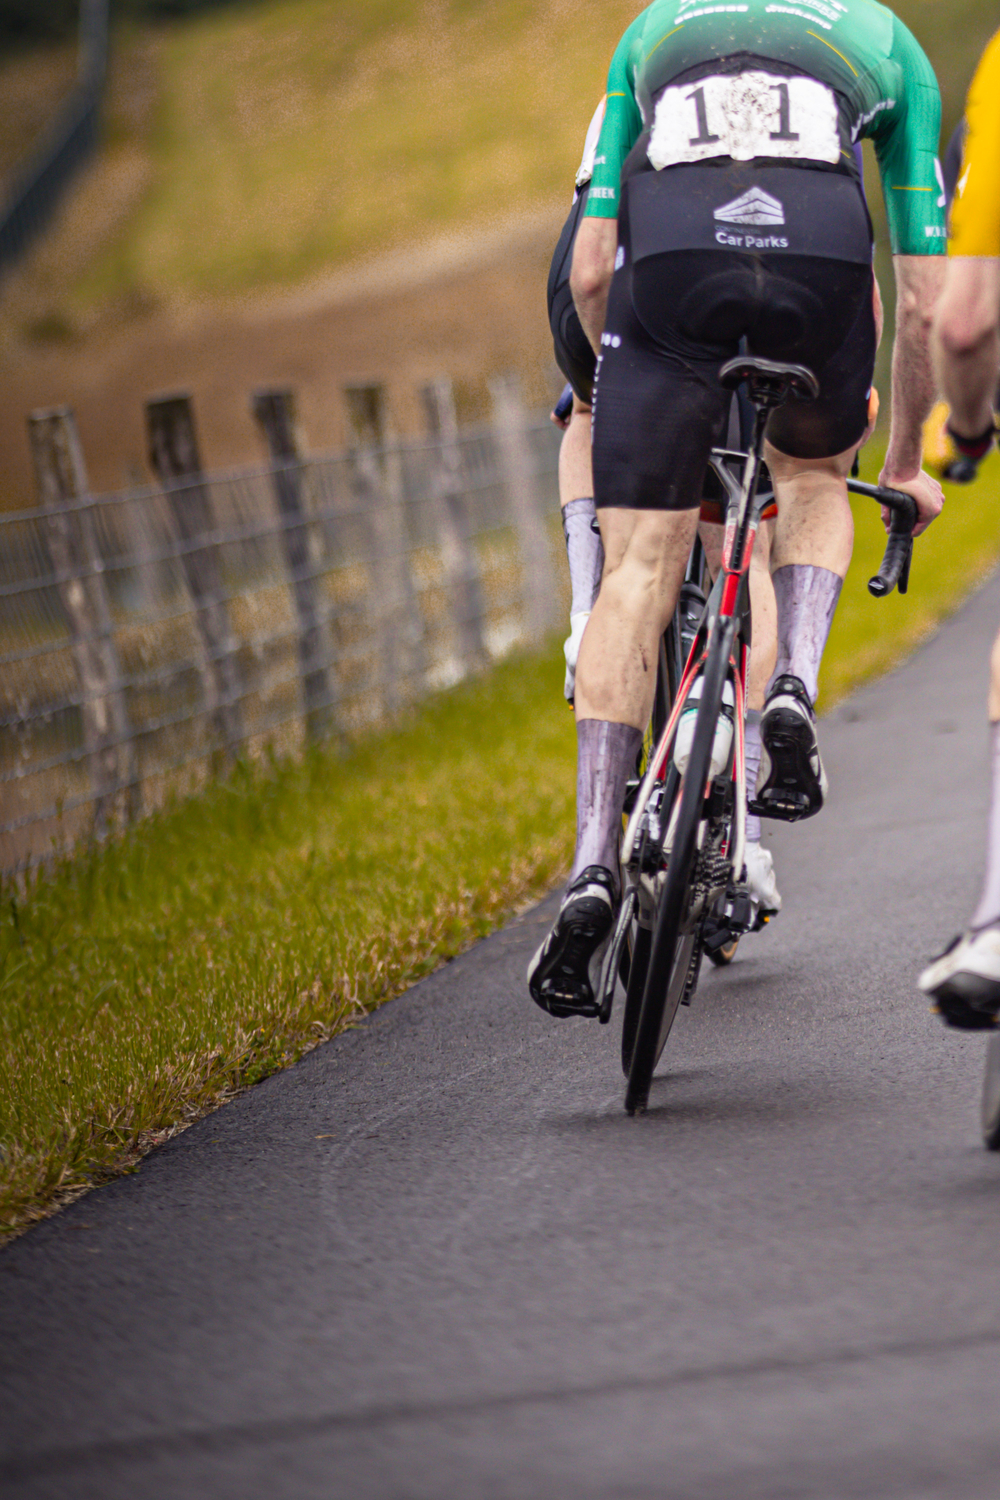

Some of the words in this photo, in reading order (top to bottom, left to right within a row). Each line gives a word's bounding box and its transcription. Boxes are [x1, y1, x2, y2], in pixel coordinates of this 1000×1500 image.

[765, 3, 833, 30] Wildkamp
[715, 231, 743, 247] Car
[745, 234, 789, 248] Parks
